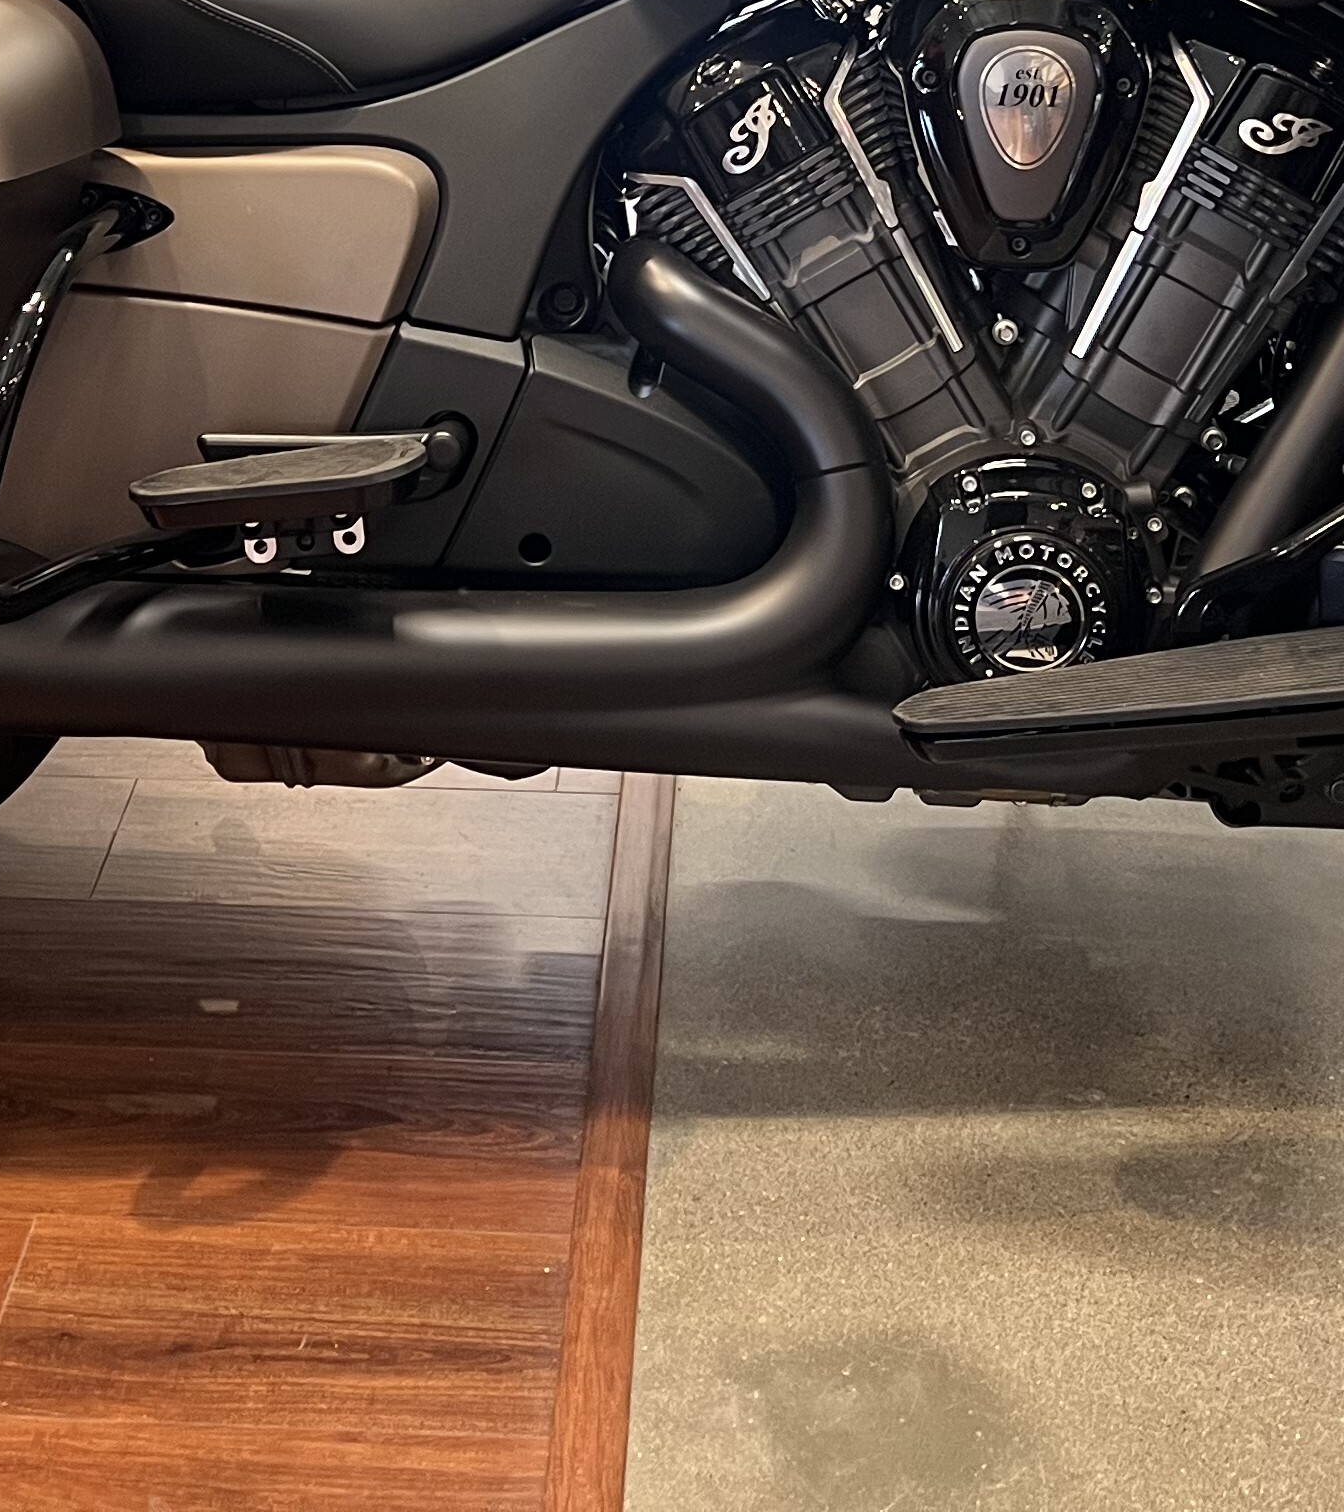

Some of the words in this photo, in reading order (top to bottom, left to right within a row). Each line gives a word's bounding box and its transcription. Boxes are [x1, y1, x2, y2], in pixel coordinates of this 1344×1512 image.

[996, 82, 1060, 108] 1901
[954, 563, 989, 665] INDIAN
[994, 543, 1107, 665] MOTORCYCLE
